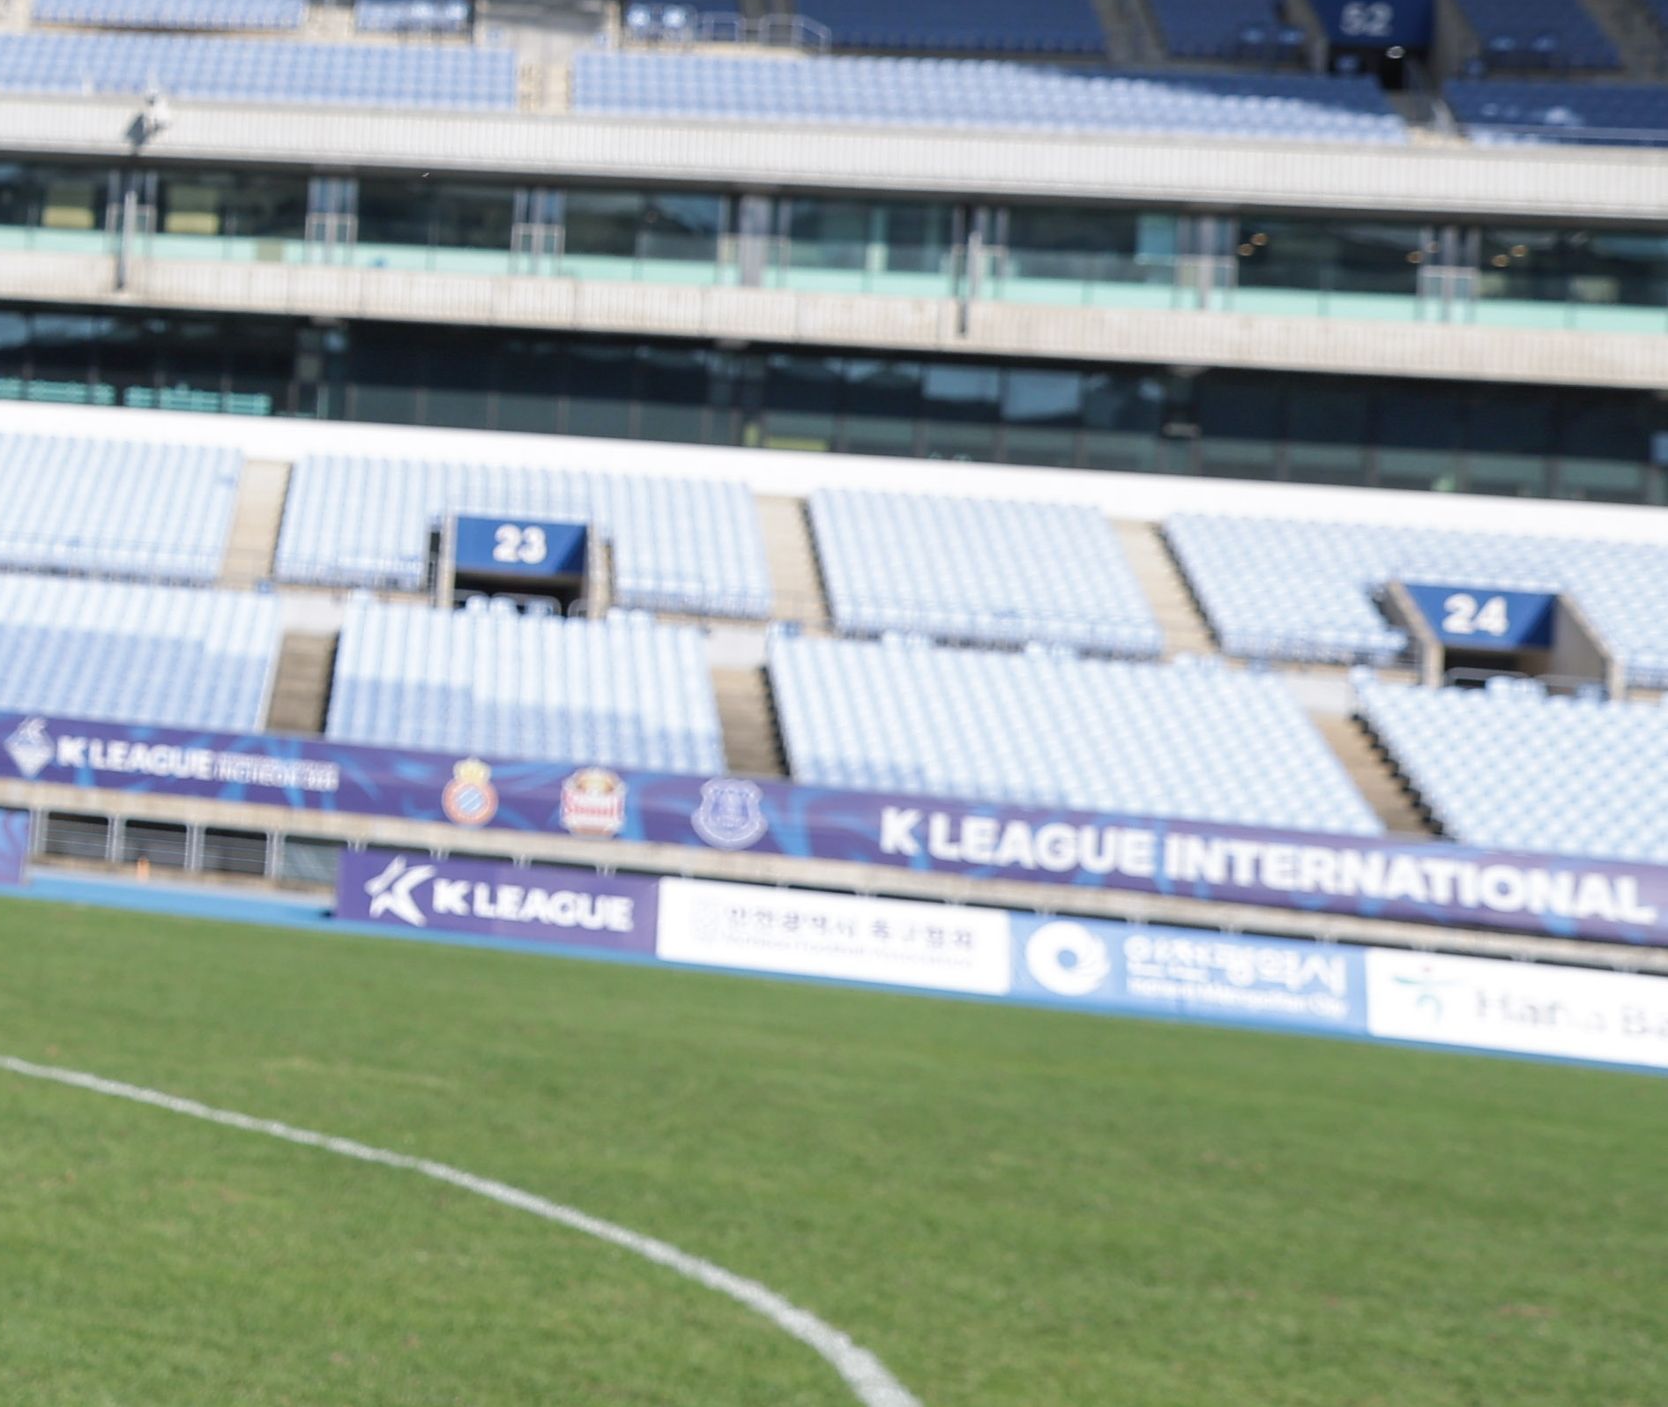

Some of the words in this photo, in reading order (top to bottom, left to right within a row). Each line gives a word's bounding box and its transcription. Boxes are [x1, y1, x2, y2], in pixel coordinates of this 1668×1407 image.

[492, 523, 548, 564] 23
[1441, 593, 1509, 636] 24
[59, 735, 86, 764] K
[88, 737, 214, 779] LEAGUE
[880, 806, 924, 855] K
[928, 812, 1163, 877] LEAGUE
[1164, 832, 1657, 925] INTERNATIONAL
[432, 878, 469, 913] K
[473, 884, 635, 933] LEAGUE
